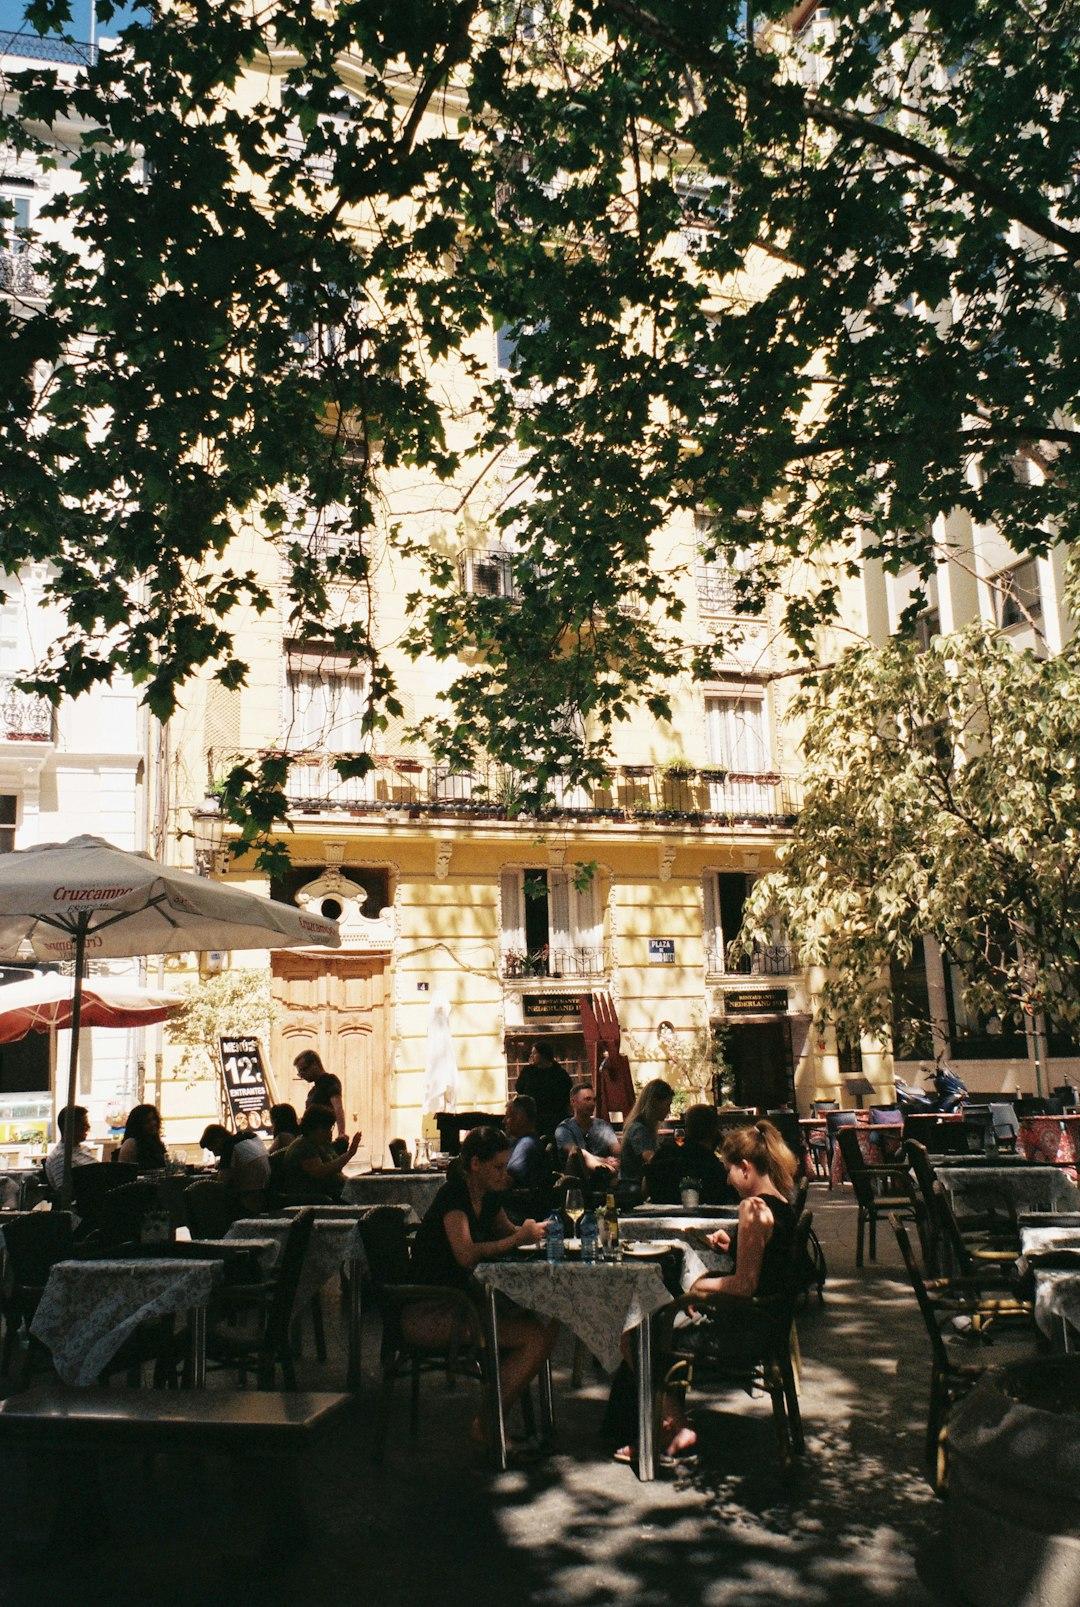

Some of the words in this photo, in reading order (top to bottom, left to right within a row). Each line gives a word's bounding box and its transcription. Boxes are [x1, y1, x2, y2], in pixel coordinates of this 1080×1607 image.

[53, 886, 133, 901] Cruzcamp
[651, 940, 671, 948] PLAZA
[527, 1004, 574, 1012] NEDERLAND
[230, 1086, 266, 1098] ENTRANTES
